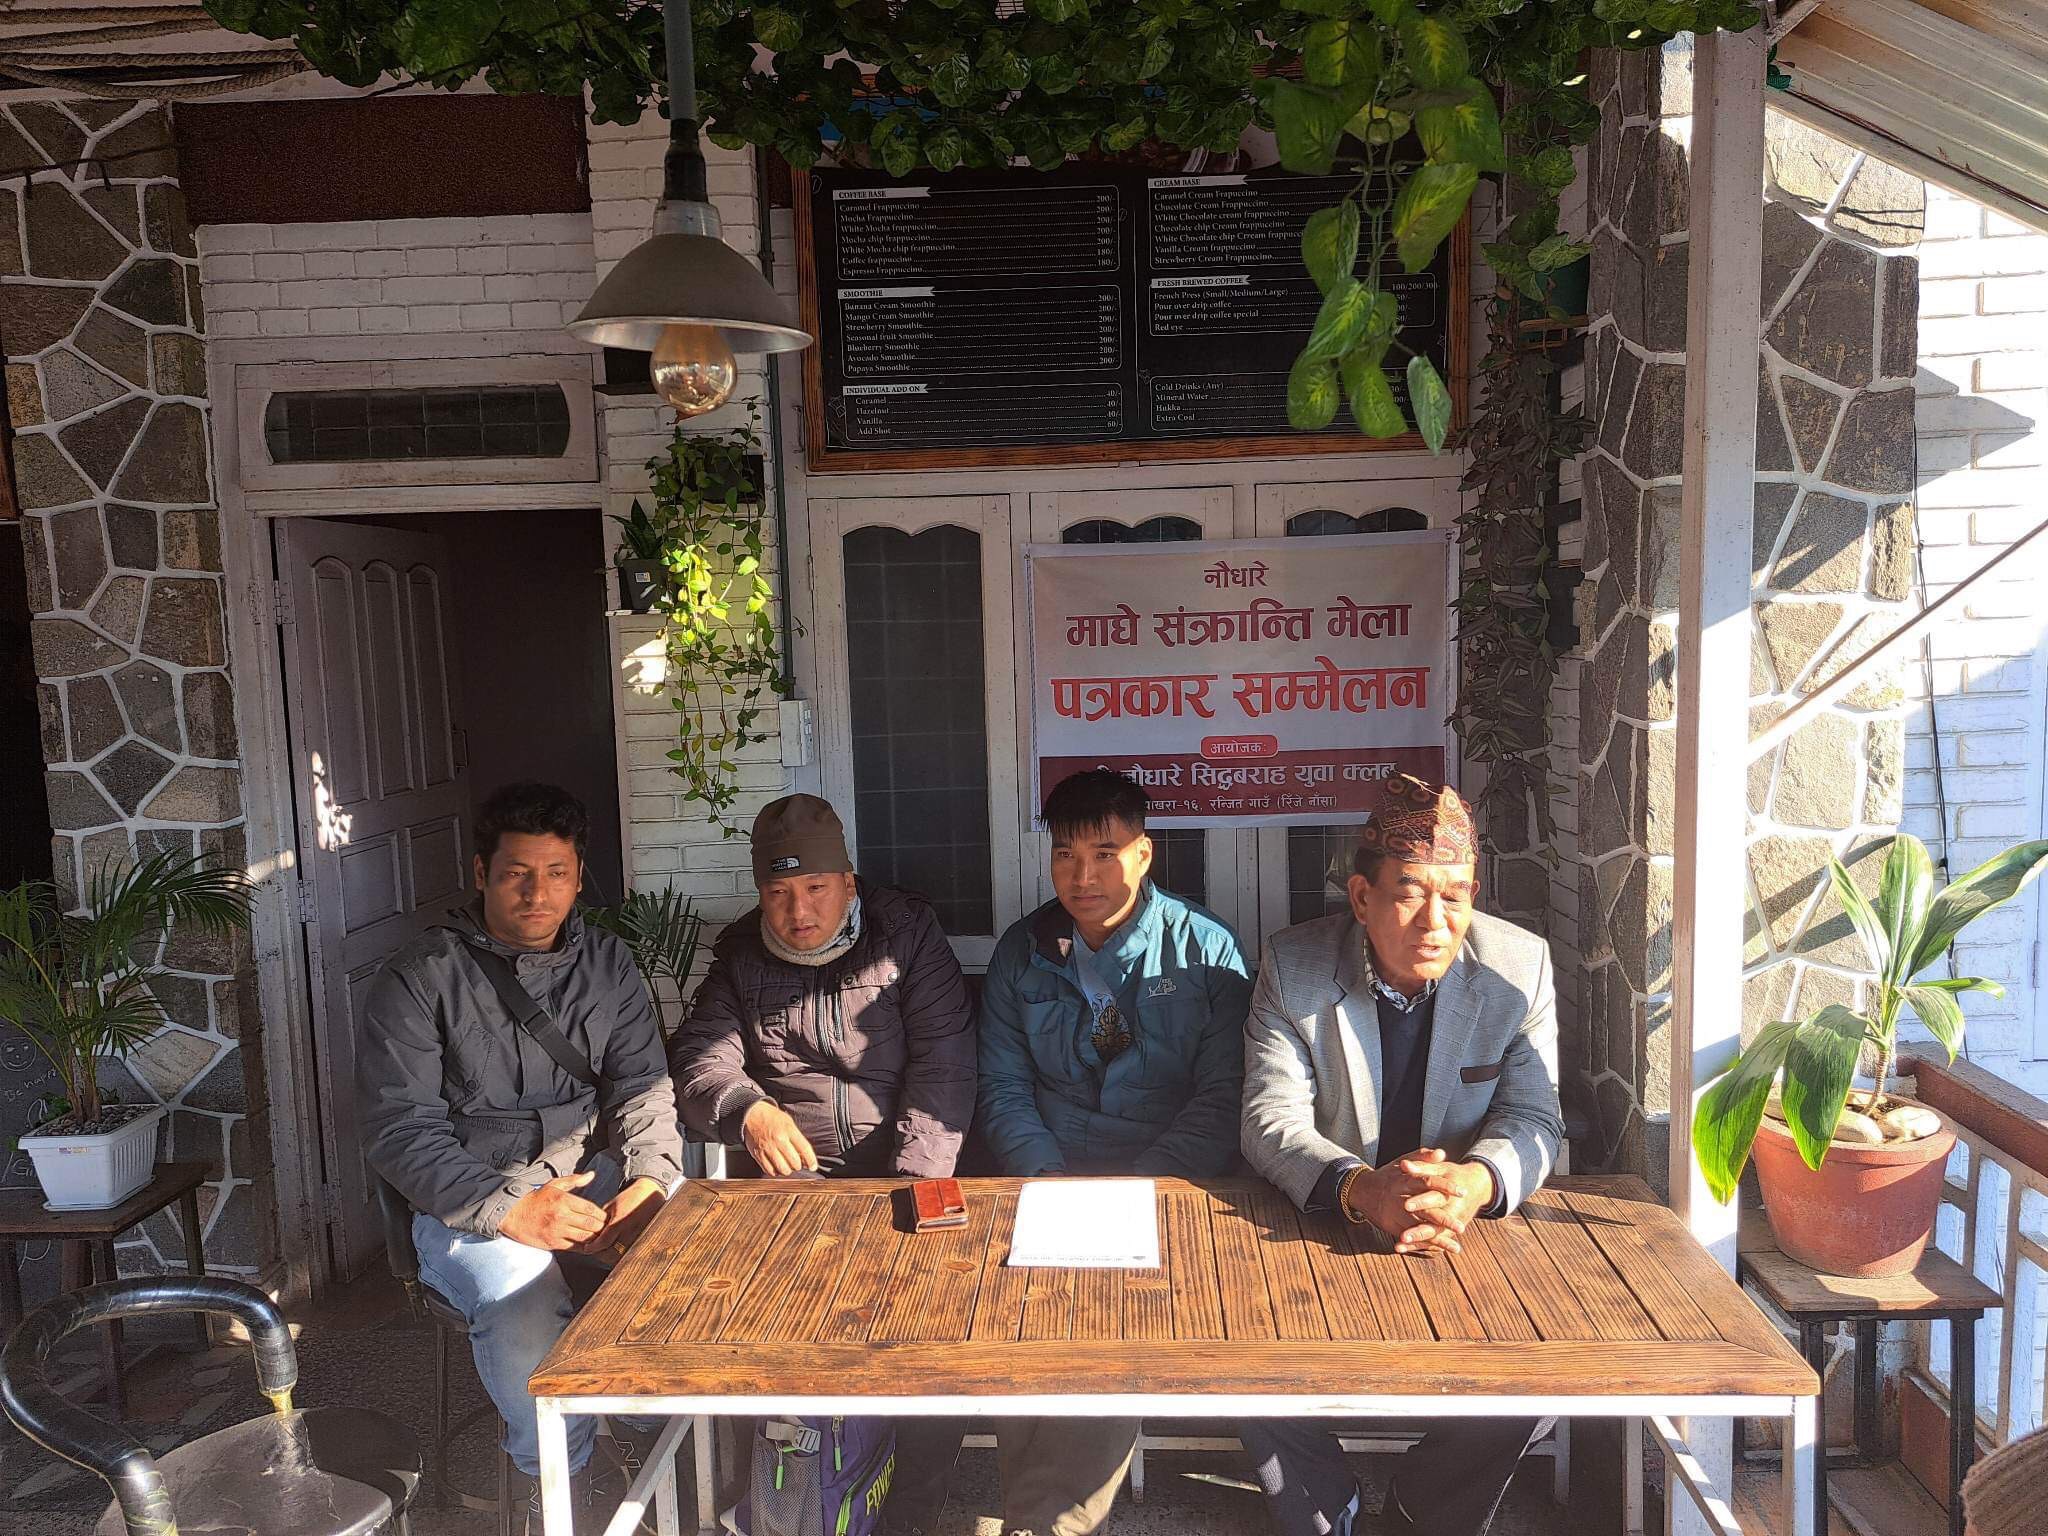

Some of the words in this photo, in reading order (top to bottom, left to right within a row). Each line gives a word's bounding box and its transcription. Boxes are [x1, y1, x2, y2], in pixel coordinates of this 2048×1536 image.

[1153, 179, 1181, 187] CREAM
[1154, 192, 1187, 200] Caramel
[1188, 191, 1214, 199] Cream
[839, 204, 872, 212] Caramel
[873, 203, 920, 213] Frappuccino
[1154, 203, 1192, 211] Chocolate
[1194, 202, 1219, 210] Cream
[1221, 200, 1269, 210] Frappuccino
[840, 214, 865, 222] Mocha
[867, 213, 914, 223] Frappuccino
[1155, 213, 1178, 222] White
[1179, 212, 1217, 221] Chocolate
[1244, 210, 1289, 220] frappuccino
[841, 225, 864, 233] White
[865, 224, 891, 232] Mocha
[892, 224, 936, 233] frappuccino
[1154, 224, 1192, 233] Chocolate
[1194, 223, 1211, 232] chip
[1212, 222, 1237, 230] Cream
[1239, 221, 1285, 231] frappuccino
[841, 235, 866, 244] Mocha
[868, 235, 884, 244] chip
[885, 234, 931, 244] frappuccino
[1155, 235, 1178, 243] White
[1179, 234, 1217, 242] Chocolate
[1219, 233, 1235, 242] chip
[842, 246, 865, 254] White
[892, 245, 909, 254] chip
[910, 245, 955, 254] frappuccino
[1154, 246, 1181, 254] Vanilla
[1183, 245, 1209, 253] Cream
[1210, 243, 1256, 253] frappuccino
[842, 257, 866, 265] Coffee
[867, 256, 912, 265] frappuccino
[1198, 255, 1223, 263] Cream
[1225, 253, 1273, 263] Frappuccino
[843, 268, 876, 276] Espresso
[1216, 277, 1243, 285] COFFEE
[1154, 291, 1179, 300] French
[1181, 291, 1201, 299] Press
[1202, 288, 1289, 300] (Small/Medium/Large)
[844, 303, 872, 311] Banana
[900, 301, 935, 309] Smoothie
[1192, 301, 1208, 311] drip
[1210, 301, 1232, 309] coffee
[845, 313, 870, 322] Mango
[872, 312, 897, 320] Cream
[898, 311, 934, 319] Smoothie
[1154, 313, 1172, 321] Pour
[1192, 312, 1208, 321] drip
[1210, 311, 1232, 319] coffee
[1233, 310, 1259, 319] special
[887, 322, 922, 330] Smoothie
[846, 333, 878, 342] Seasonal
[879, 332, 897, 341] fruit
[898, 332, 933, 340] Smoothie
[884, 343, 920, 351] Smoothie
[848, 354, 879, 362] Avocado
[880, 353, 916, 361] Smoothie
[848, 365, 873, 374] Papaya
[875, 364, 911, 372] Smoothie
[1155, 383, 1173, 391] Cold
[1175, 382, 1201, 391] Drinks
[1202, 382, 1224, 391] (Any)
[855, 396, 886, 405] Caramel
[1156, 393, 1185, 401] Mineral
[856, 407, 889, 415] Hazelnut
[1156, 404, 1181, 412] Hukka
[856, 417, 883, 425] Vanilla
[1156, 414, 1176, 422] Extra
[1177, 413, 1195, 421] Coal
[857, 427, 873, 435] Add
[874, 427, 891, 435] Shot
[1204, 560, 1269, 588] नौधारे
[1066, 603, 1141, 647] माघे
[1153, 598, 1315, 647] संक्रान्ति
[1327, 595, 1412, 639] मेला
[1050, 674, 1218, 721] पत्रकार
[1232, 655, 1431, 717] सम्मेलन
[1295, 764, 1337, 788] युवा
